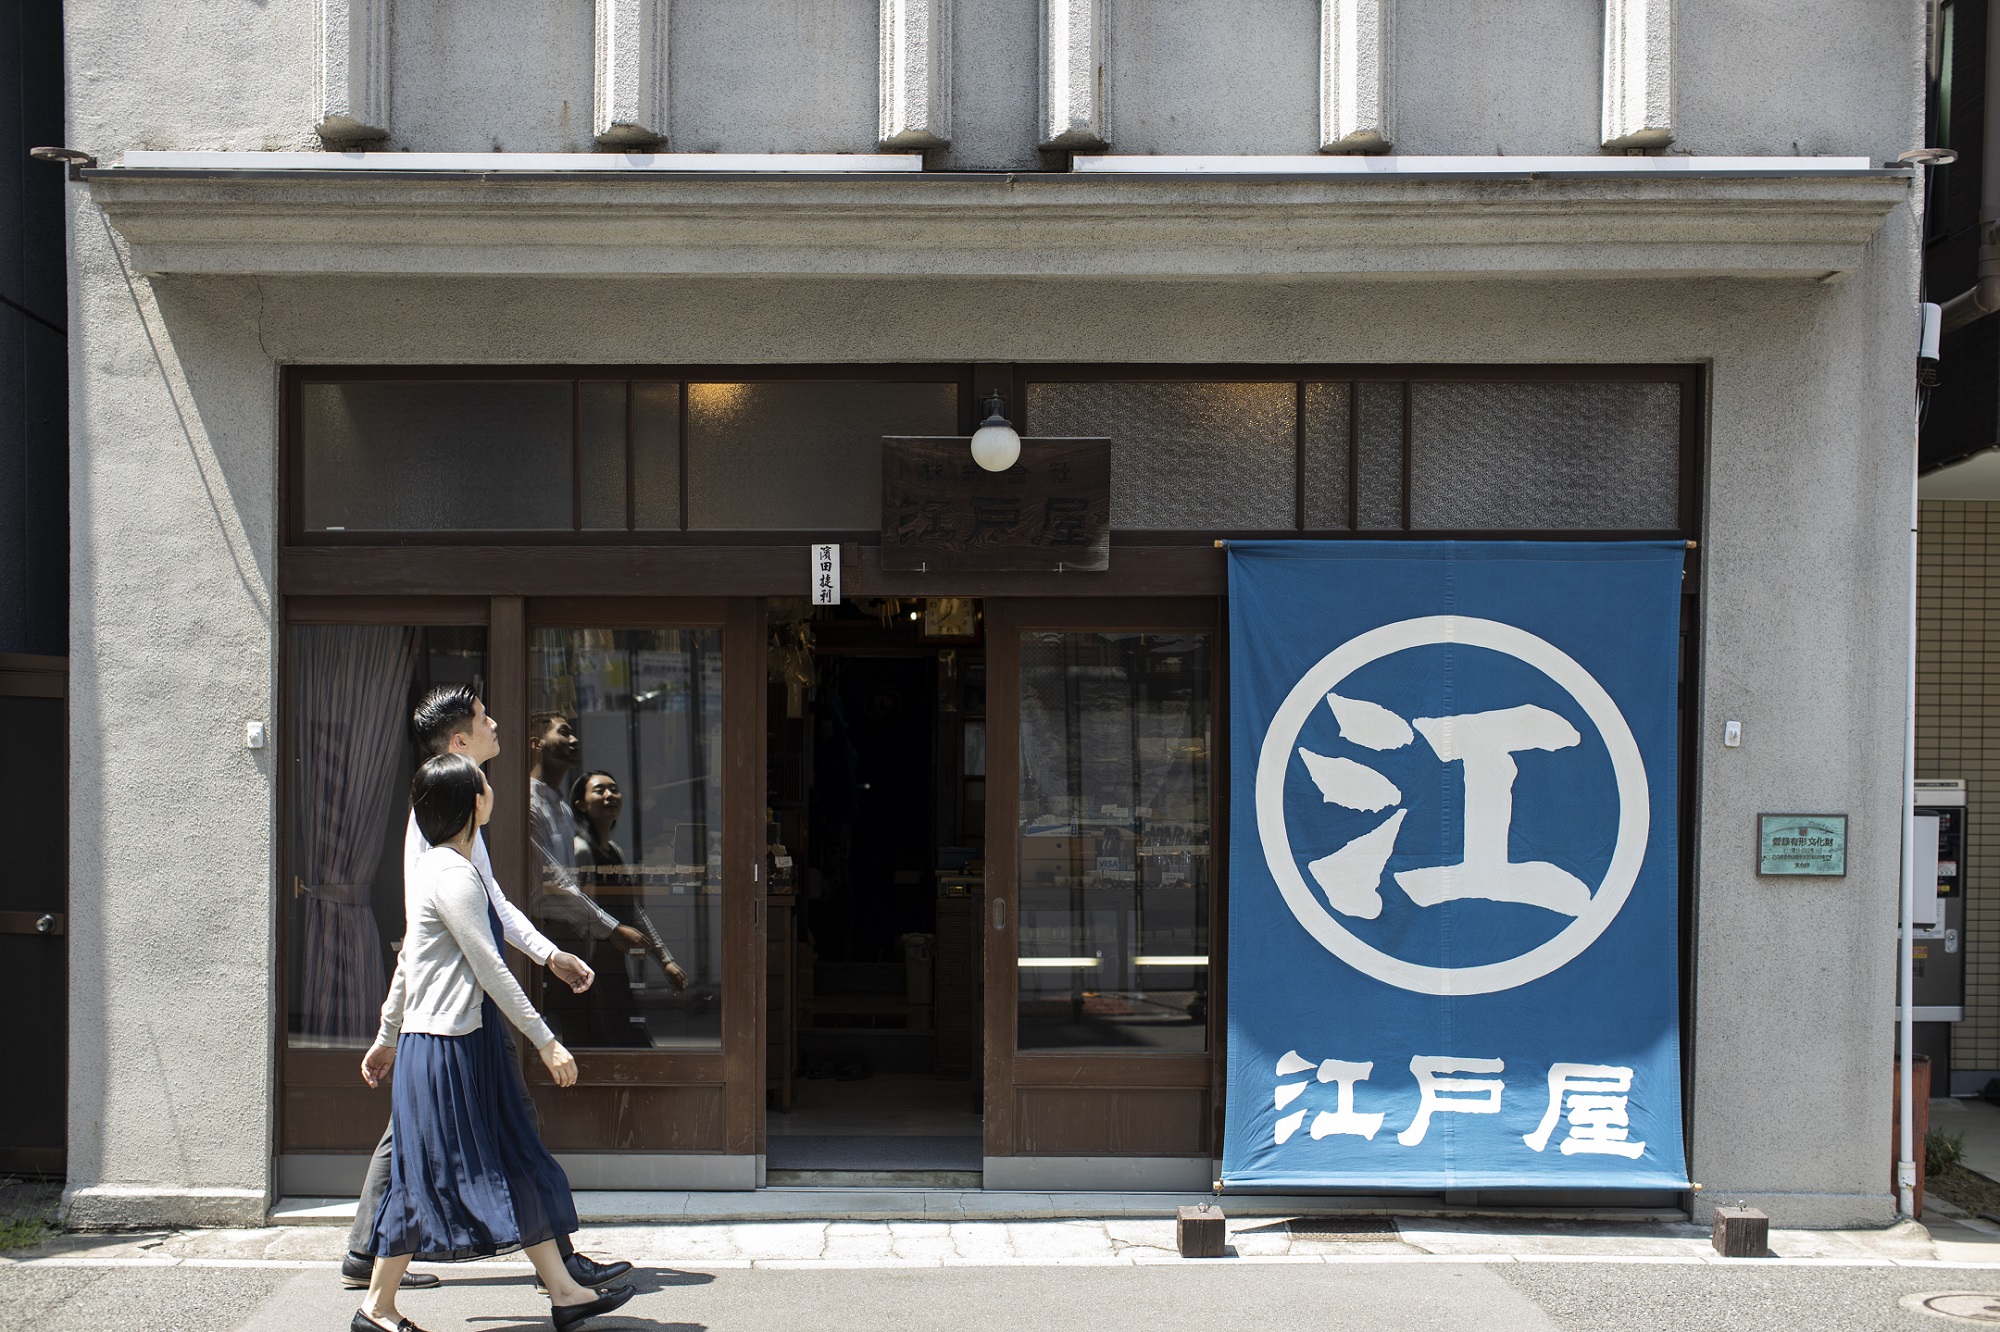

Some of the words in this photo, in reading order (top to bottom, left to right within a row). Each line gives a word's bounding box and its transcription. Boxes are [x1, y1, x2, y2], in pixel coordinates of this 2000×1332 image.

[1299, 692, 1592, 920] 江
[1275, 1050, 1646, 1160] 江戸屋
